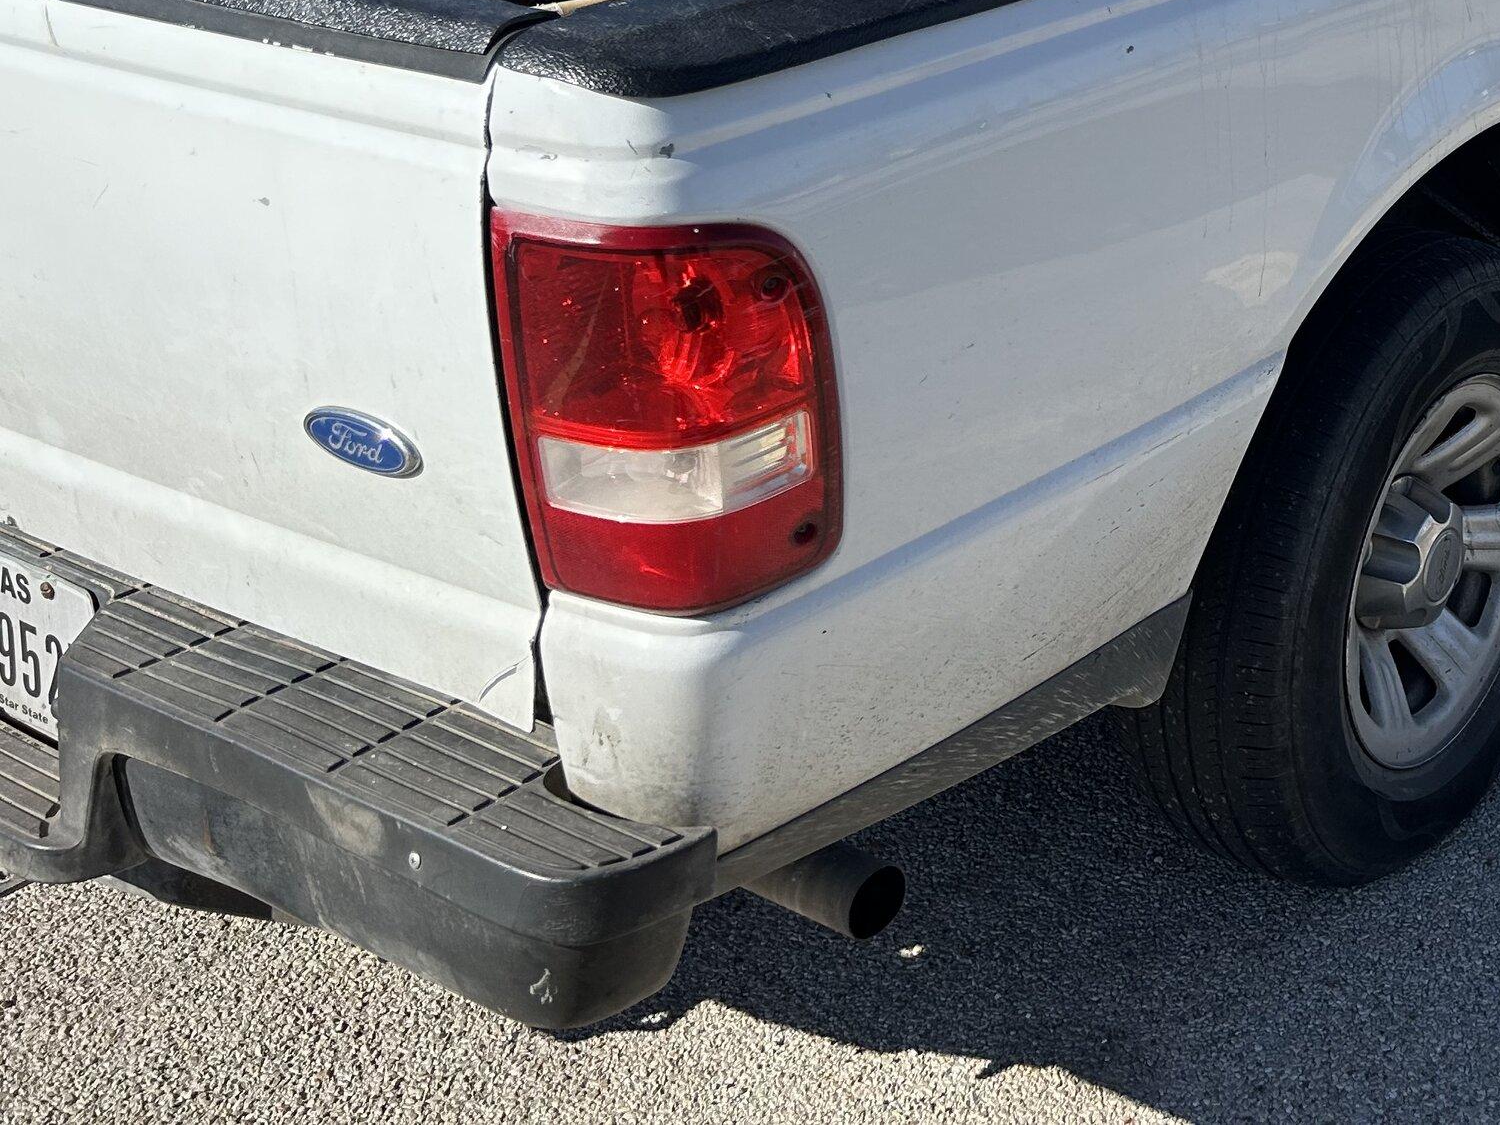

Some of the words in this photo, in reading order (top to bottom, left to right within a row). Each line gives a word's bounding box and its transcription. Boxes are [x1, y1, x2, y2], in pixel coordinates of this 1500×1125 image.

[328, 422, 384, 464] Ford
[0, 693, 19, 711] Star
[21, 704, 49, 725] State
